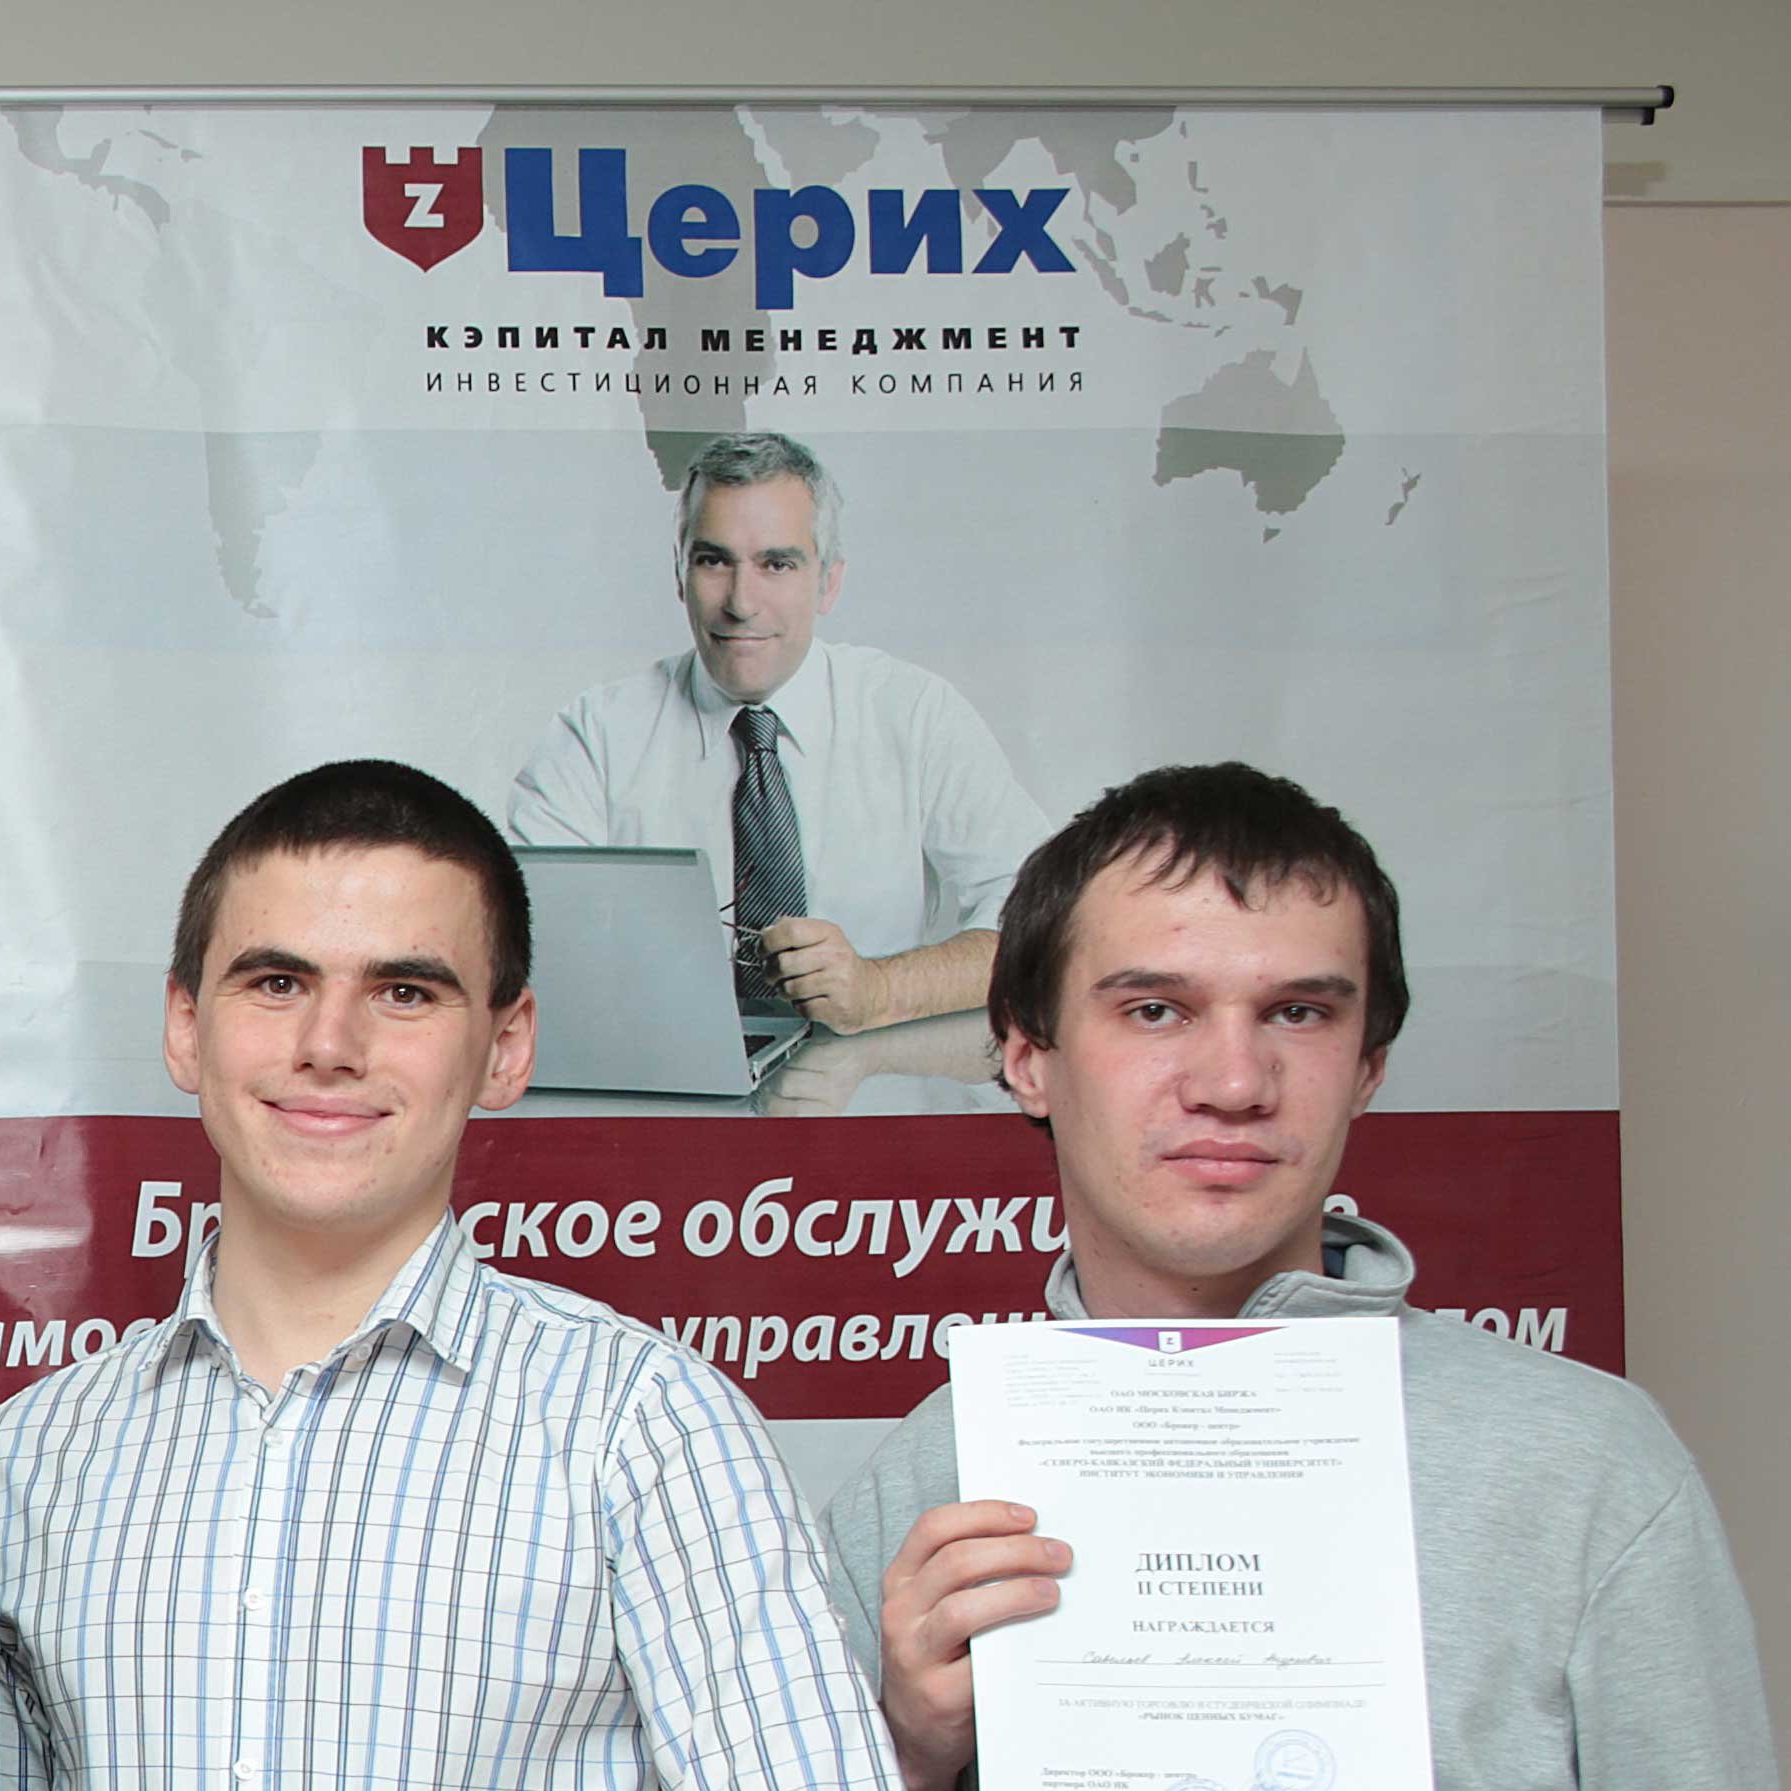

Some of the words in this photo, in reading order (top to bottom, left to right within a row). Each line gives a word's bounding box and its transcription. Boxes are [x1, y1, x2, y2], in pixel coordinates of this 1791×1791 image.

[505, 147, 1078, 310] Церих
[426, 326, 669, 351] КЭПИТАЛ
[700, 326, 1081, 354] МЕНЕДЖМЕНТ
[426, 371, 818, 397] ИНВЕСТИЦИОННАЯ
[851, 371, 1084, 395] КОМПАНИЯ
[682, 1177, 1072, 1279] обслужи
[1135, 1552, 1262, 1576] ДИПЛОМ
[1157, 1581, 1264, 1597] СТЕПЕНИ
[1131, 1620, 1276, 1635] НАГРАЖДАЕТСЯ
